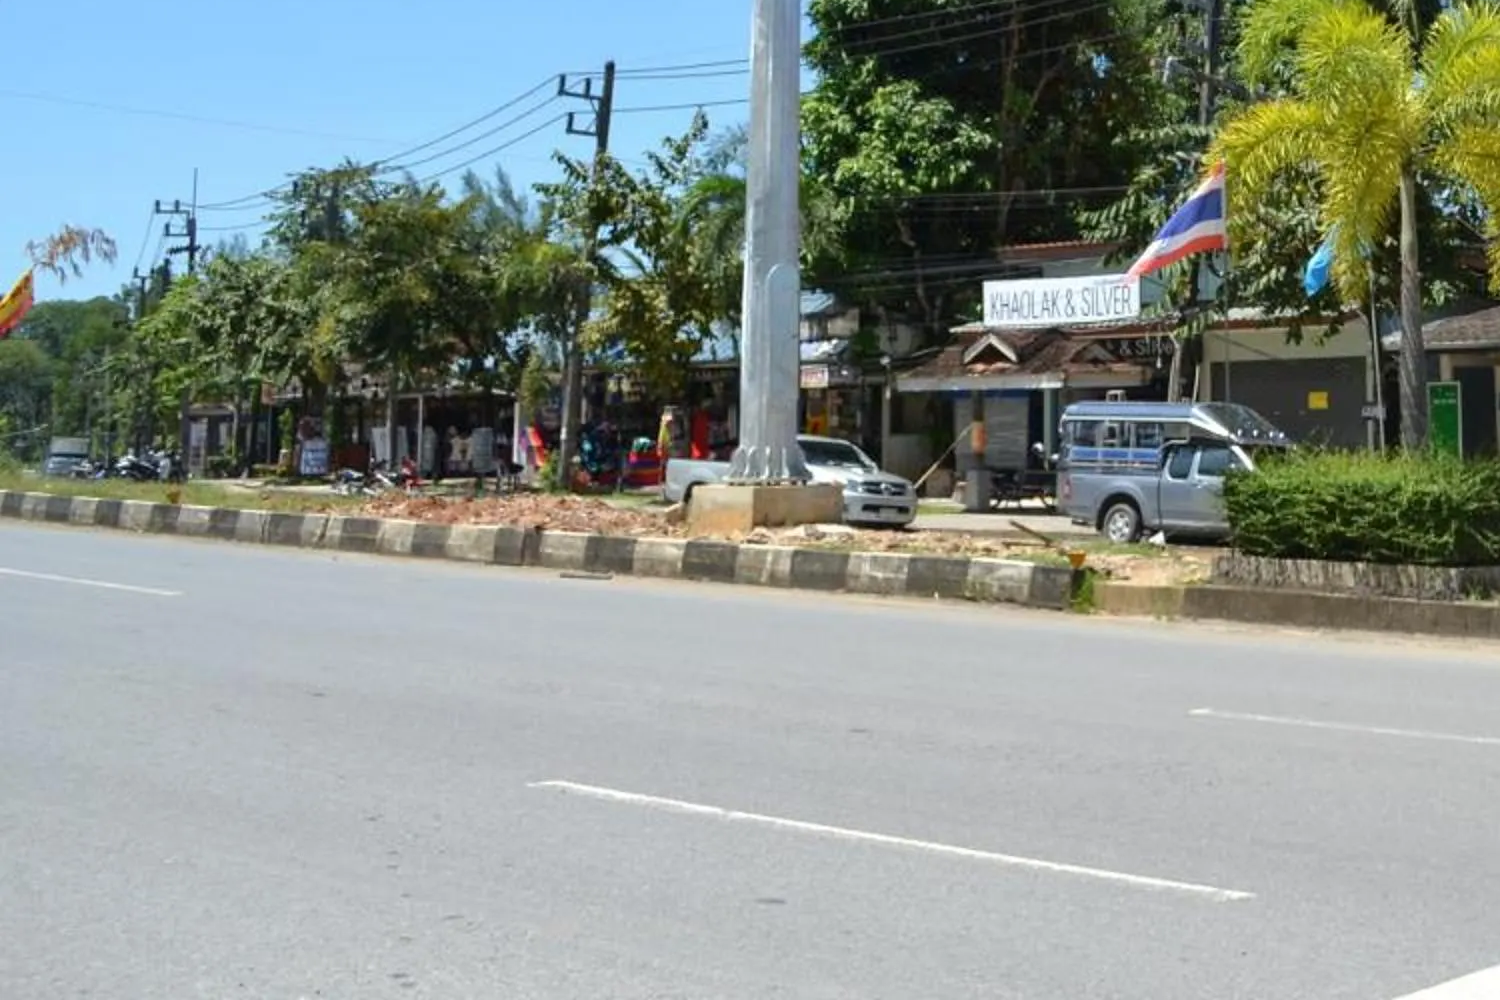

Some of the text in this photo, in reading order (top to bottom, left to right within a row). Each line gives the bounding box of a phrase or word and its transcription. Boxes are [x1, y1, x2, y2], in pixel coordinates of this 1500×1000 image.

[989, 285, 1132, 321] KHAOLAK & SILVER
